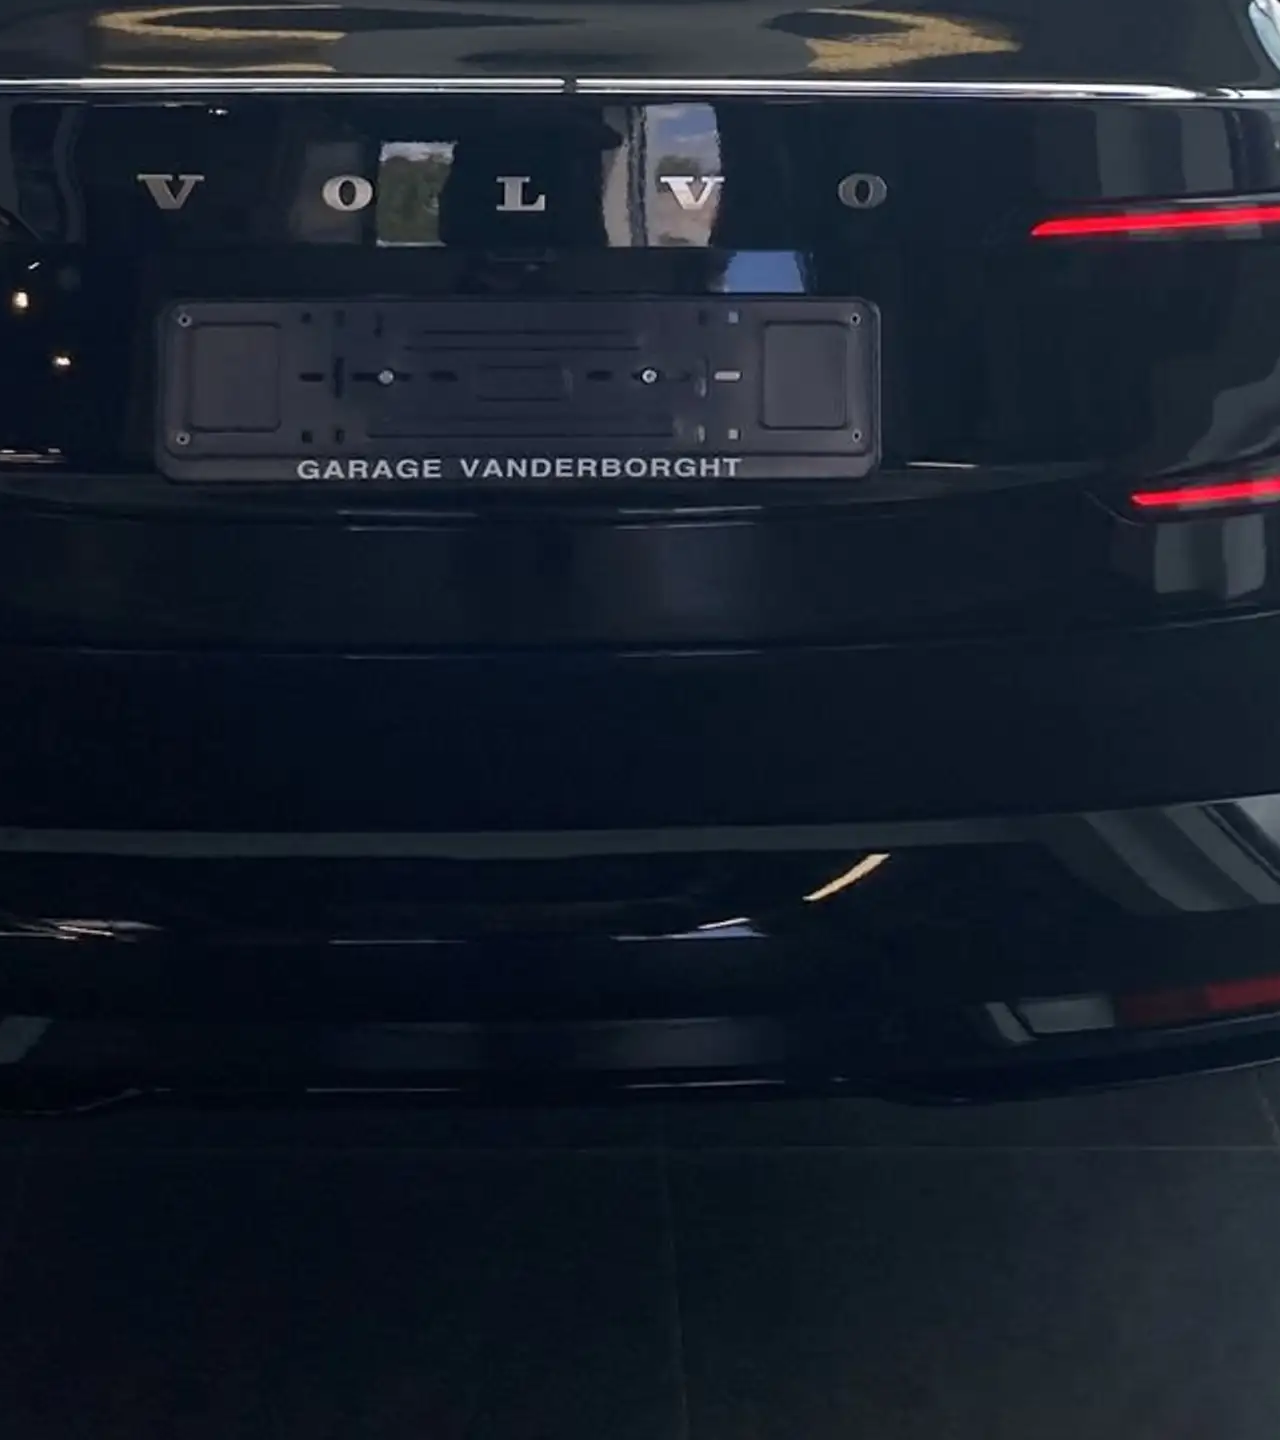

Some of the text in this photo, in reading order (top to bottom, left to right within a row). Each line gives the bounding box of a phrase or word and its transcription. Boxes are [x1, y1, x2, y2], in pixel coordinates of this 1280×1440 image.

[137, 174, 888, 212] VOLVO
[296, 456, 744, 480] GARAGE VANDERBORGHT
